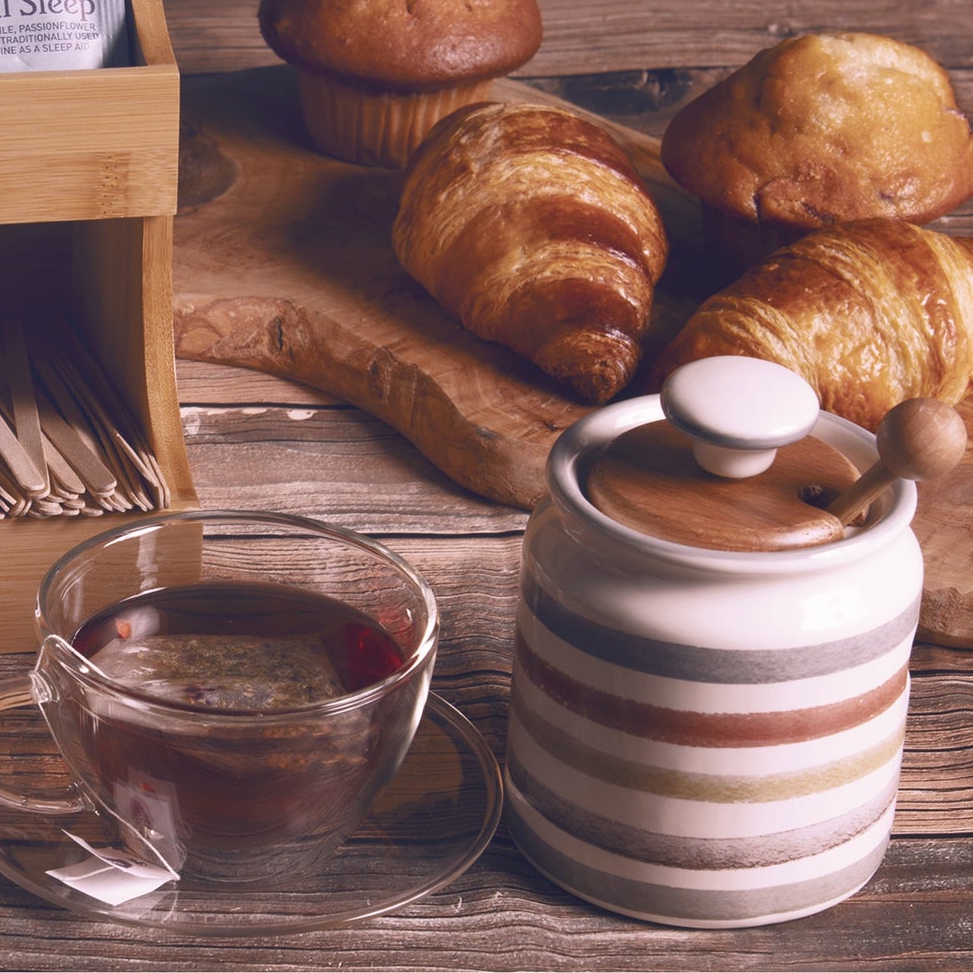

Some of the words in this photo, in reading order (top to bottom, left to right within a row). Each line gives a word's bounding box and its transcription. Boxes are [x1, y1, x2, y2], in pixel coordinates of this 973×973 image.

[19, 21, 96, 33] PASSIONFLOWER
[0, 32, 73, 46] TRADITIONALLY
[75, 31, 99, 41] USED
[19, 45, 32, 54] AS
[33, 44, 41, 53] A
[43, 42, 72, 53] SLEEP
[74, 41, 90, 52] AID
